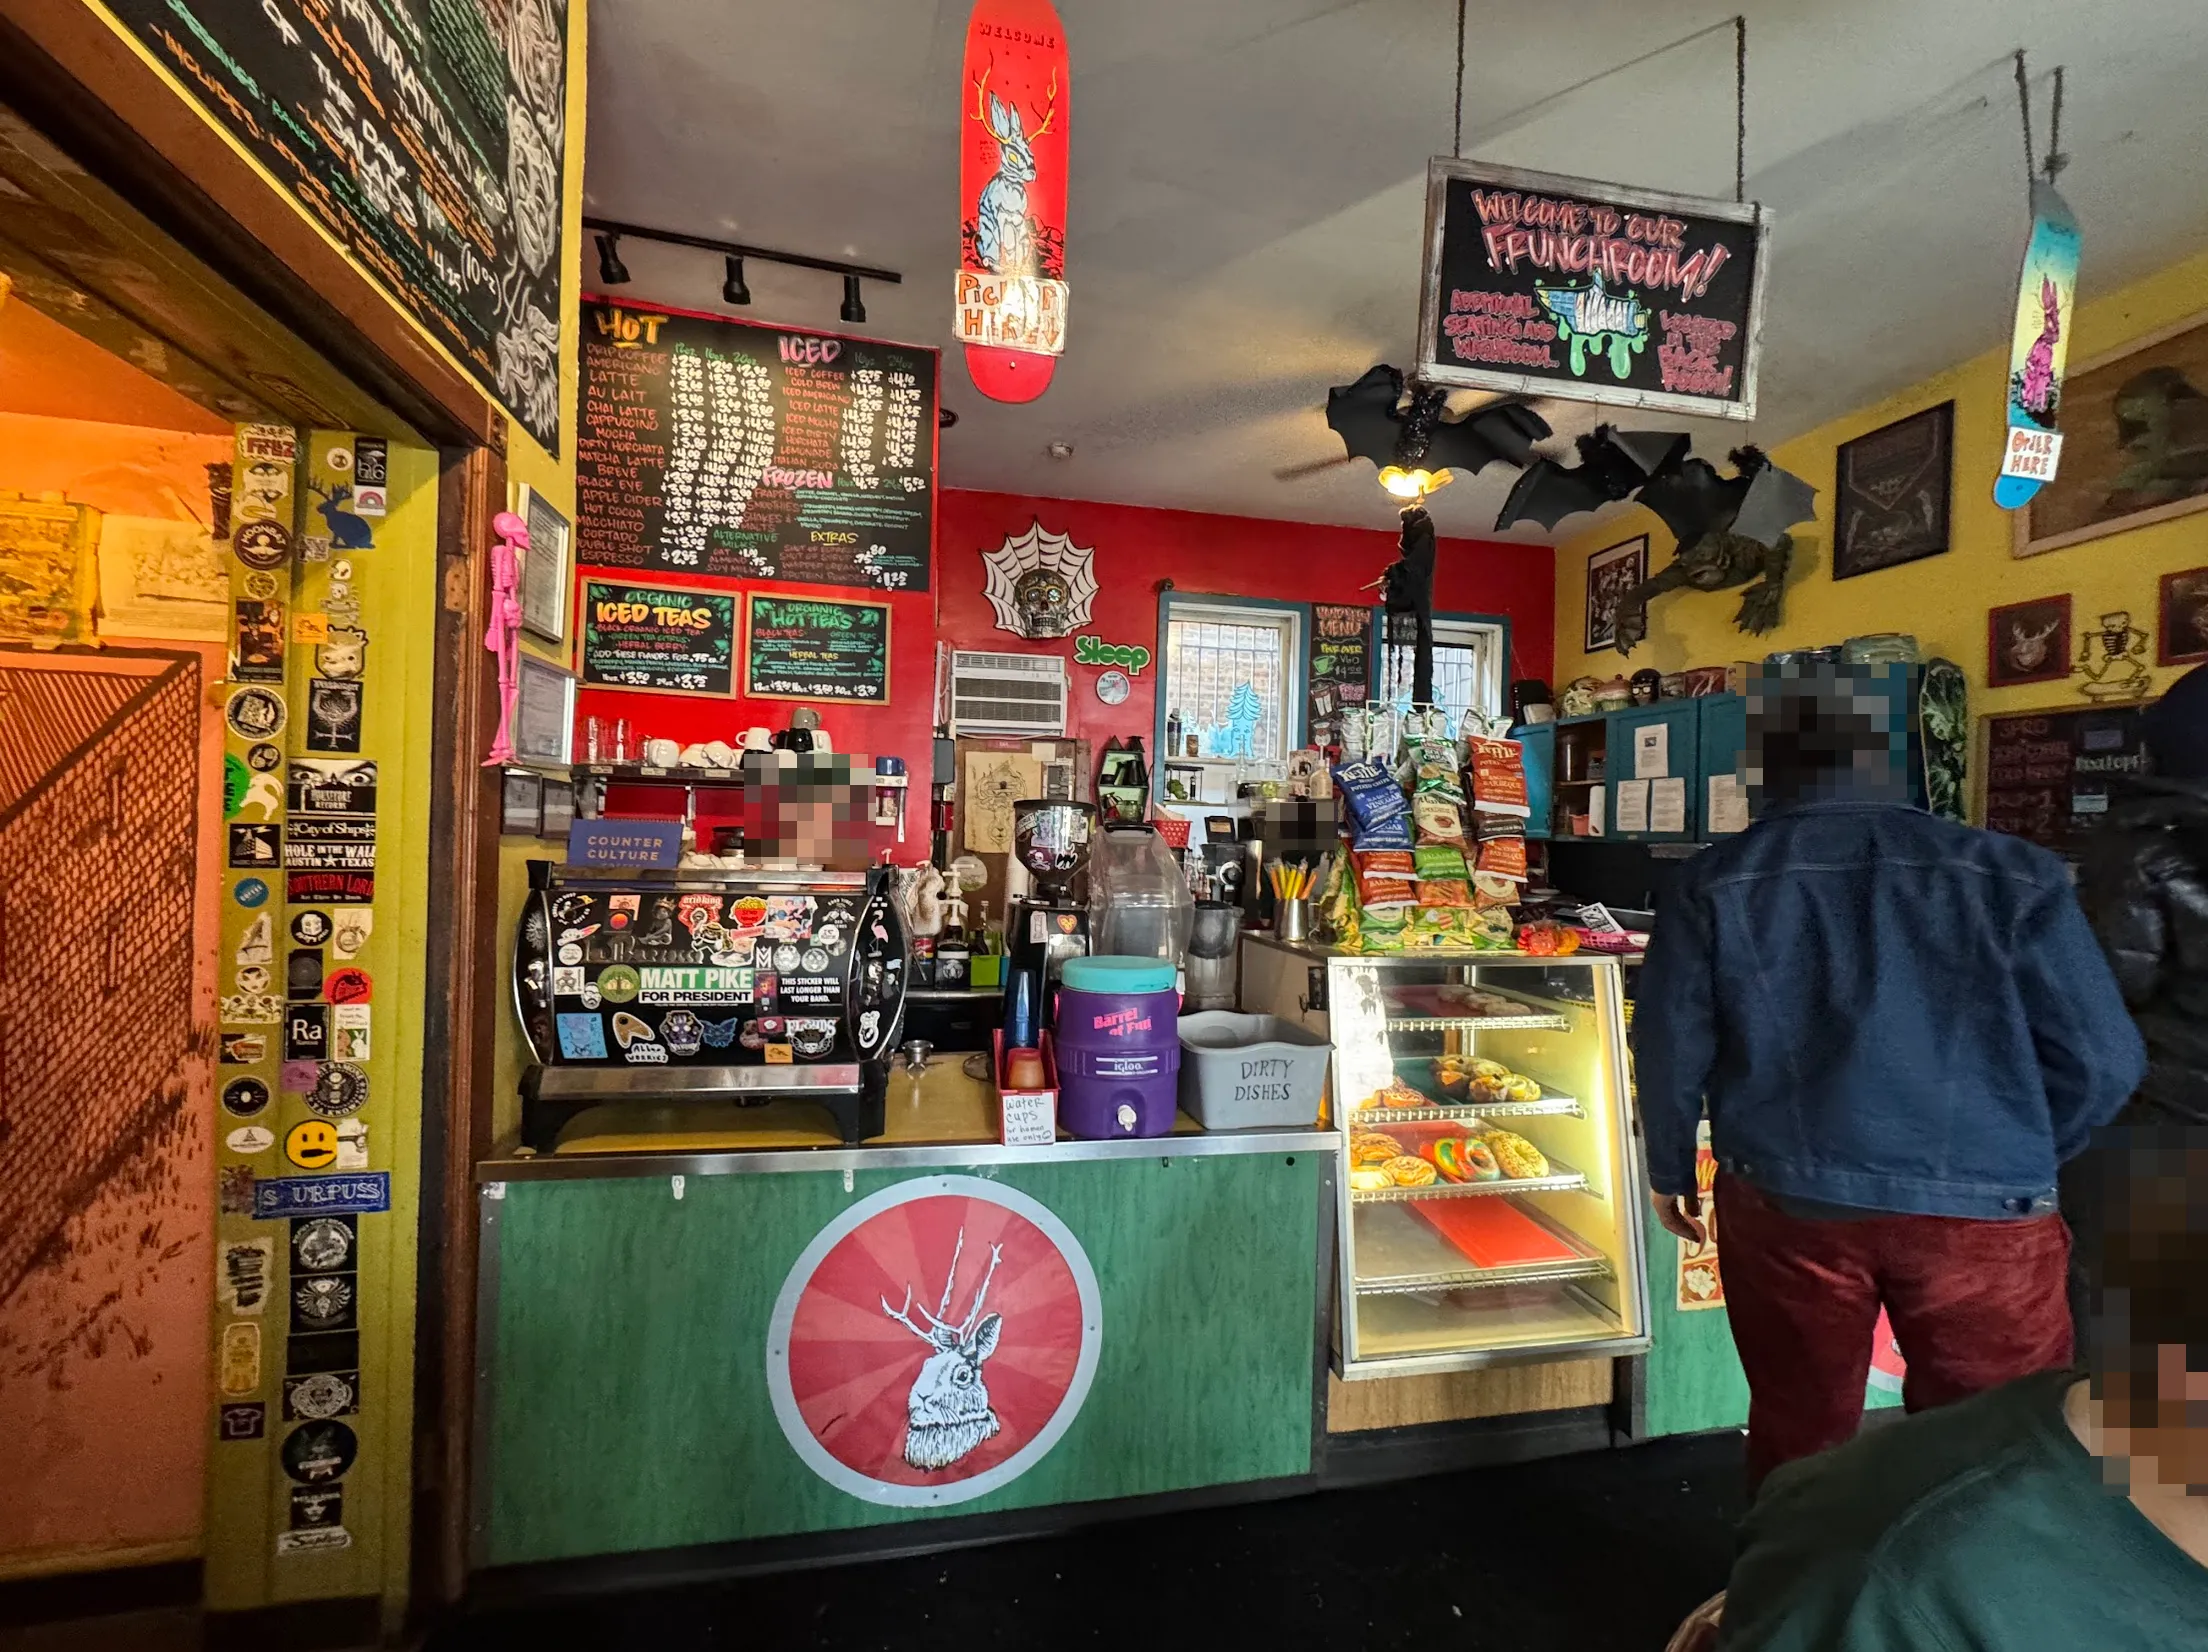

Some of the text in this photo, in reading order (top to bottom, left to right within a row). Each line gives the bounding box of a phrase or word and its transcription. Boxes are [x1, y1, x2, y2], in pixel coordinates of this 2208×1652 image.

[978, 21, 1056, 50] WELCOME
[262, 0, 357, 120] OF THE
[322, 98, 418, 228] SALADS
[1471, 189, 1686, 250] WELCOME TO OUR
[594, 309, 669, 345] HOT
[1443, 314, 1557, 342] SEATING AND
[619, 347, 668, 365] COFFEE
[778, 336, 842, 364] ICED
[586, 356, 661, 376] AMERICANO
[785, 367, 845, 381] ICED COFFEE
[590, 370, 640, 387] LATTE
[791, 377, 840, 390] COLD BREW
[888, 372, 916, 388] $4.10
[587, 385, 647, 403] AU LAIT
[782, 387, 851, 405] ICED AMERICANO
[850, 383, 883, 399] $4.50
[586, 400, 657, 420] CHAI LATTE
[789, 400, 839, 416] ICED LATTE
[585, 414, 659, 431] CAPPUCCINO
[785, 413, 839, 429] ICED MOCHA
[595, 427, 637, 441] MOCHA
[782, 426, 837, 442] ICED DIRTY
[579, 451, 666, 469] MATCHA LATTE
[780, 446, 833, 459] LEMONADE
[597, 463, 639, 478] BREVE
[811, 460, 839, 471] SODA
[2010, 455, 2048, 475] HERE
[577, 475, 644, 492] BLACK EYE
[762, 466, 834, 489] FROZEN
[582, 489, 663, 507] APPLE CIDER
[584, 502, 645, 519] HOT COCOA
[575, 515, 646, 532] MACCHIATO
[240, 525, 287, 544] MOONBAT
[582, 528, 639, 543] CORTADO
[713, 530, 778, 543] ALTERNATIVE
[810, 531, 859, 544] EXTRAS
[581, 550, 645, 565] ESPRESSO
[620, 543, 654, 555] SHOT
[625, 590, 693, 608] ORGANIC
[597, 602, 712, 629] ICED TEAS
[787, 603, 842, 615] ORGANIC
[770, 608, 855, 630] HOT TEAS
[662, 625, 682, 634] ICED
[1319, 620, 1362, 637] MENU
[594, 649, 611, 658] ADD
[672, 652, 689, 661] FOR
[655, 642, 686, 651] BERRY
[1073, 635, 1151, 676] Sleep
[300, 822, 320, 836] City
[322, 822, 335, 834] of
[588, 836, 663, 848] COUNTER
[285, 845, 315, 857] HOLE
[317, 845, 327, 854] IN
[327, 845, 343, 854] THE
[587, 849, 660, 861] CULTURE
[285, 857, 321, 867] AUSTIN
[340, 857, 375, 867] TEXAS
[640, 969, 752, 989] MATT PIKE
[642, 991, 751, 1001] FOR PRESIDENT
[780, 986, 796, 994] LAST
[791, 995, 830, 1003] YOUR BAND.
[1093, 1008, 1138, 1030] Barrel
[292, 1018, 322, 1040] Ra
[1109, 1025, 1123, 1036] of
[1241, 1059, 1295, 1079] DIRTY
[1235, 1083, 1292, 1101] DISHES
